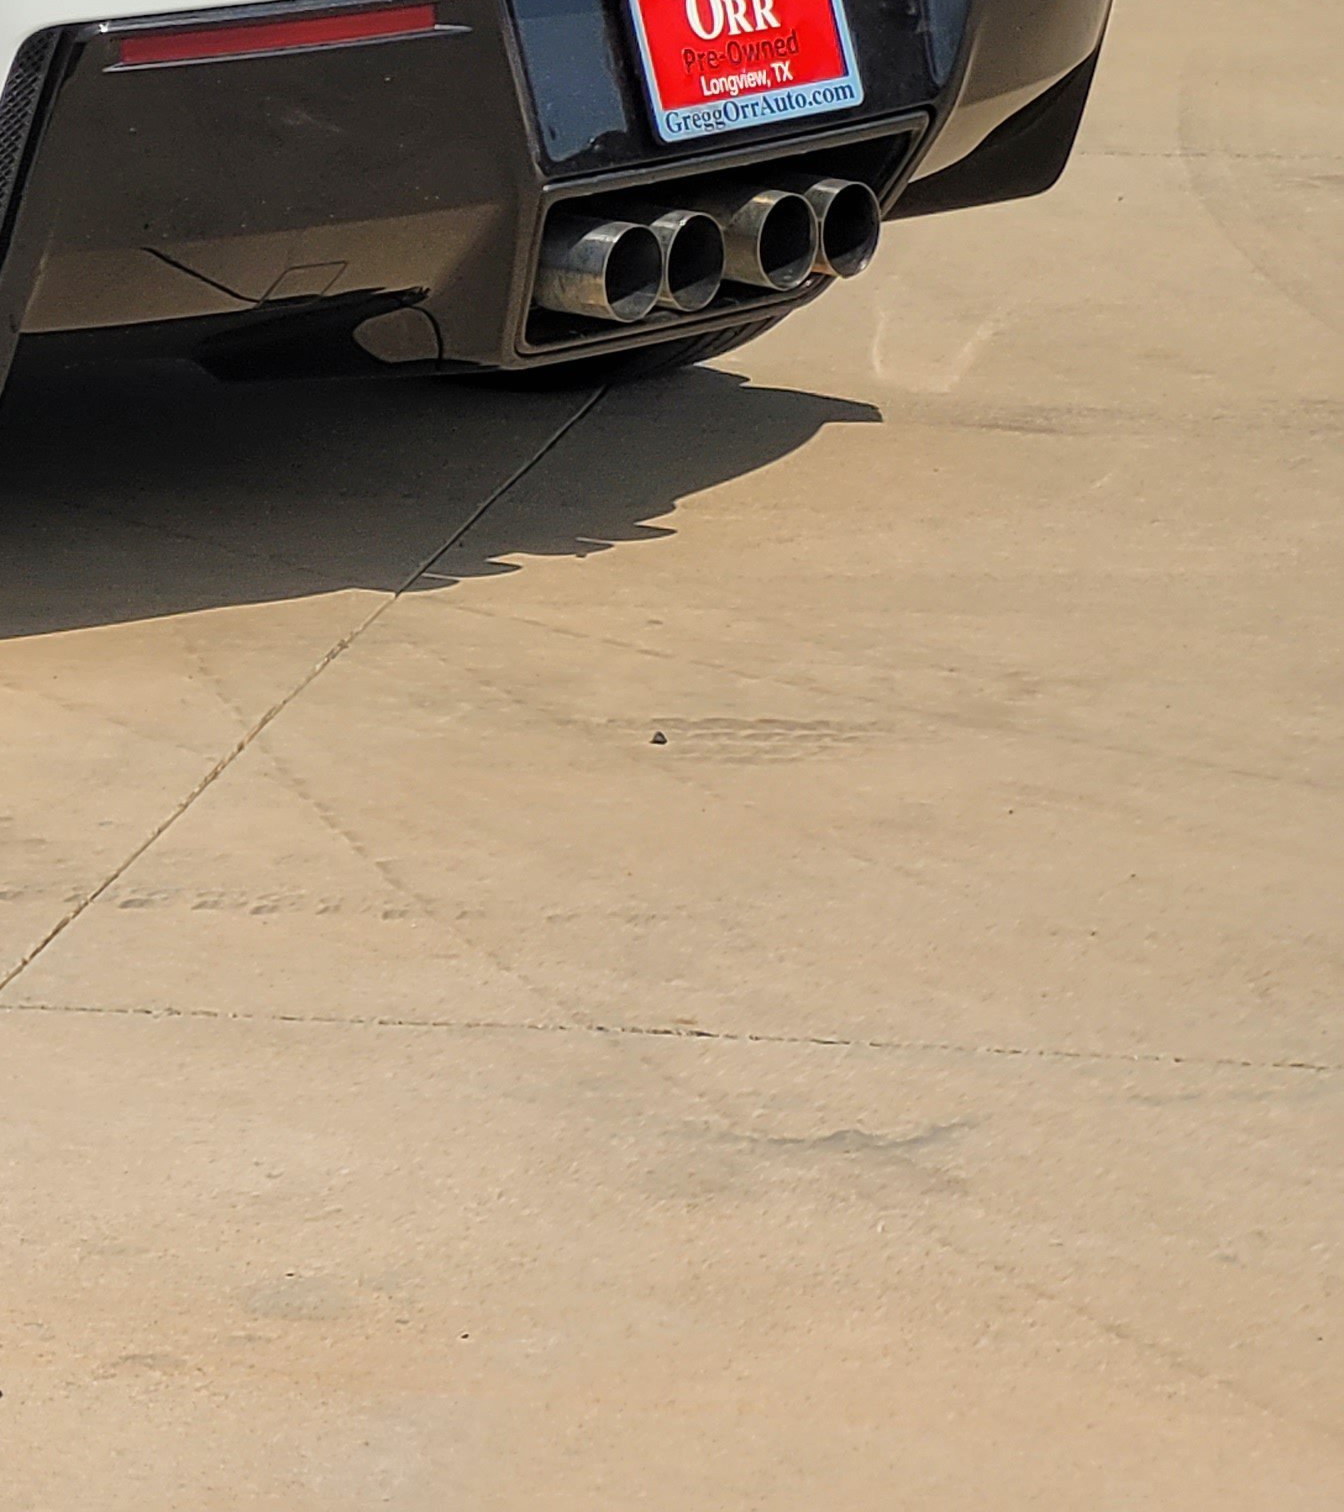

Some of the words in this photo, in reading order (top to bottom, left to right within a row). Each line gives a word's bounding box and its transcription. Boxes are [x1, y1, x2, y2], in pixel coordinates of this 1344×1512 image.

[682, 28, 800, 74] Pre-Owned
[701, 66, 772, 97] Longview,
[771, 60, 794, 84] TX
[665, 83, 856, 134] GreggOrrAuto.com
